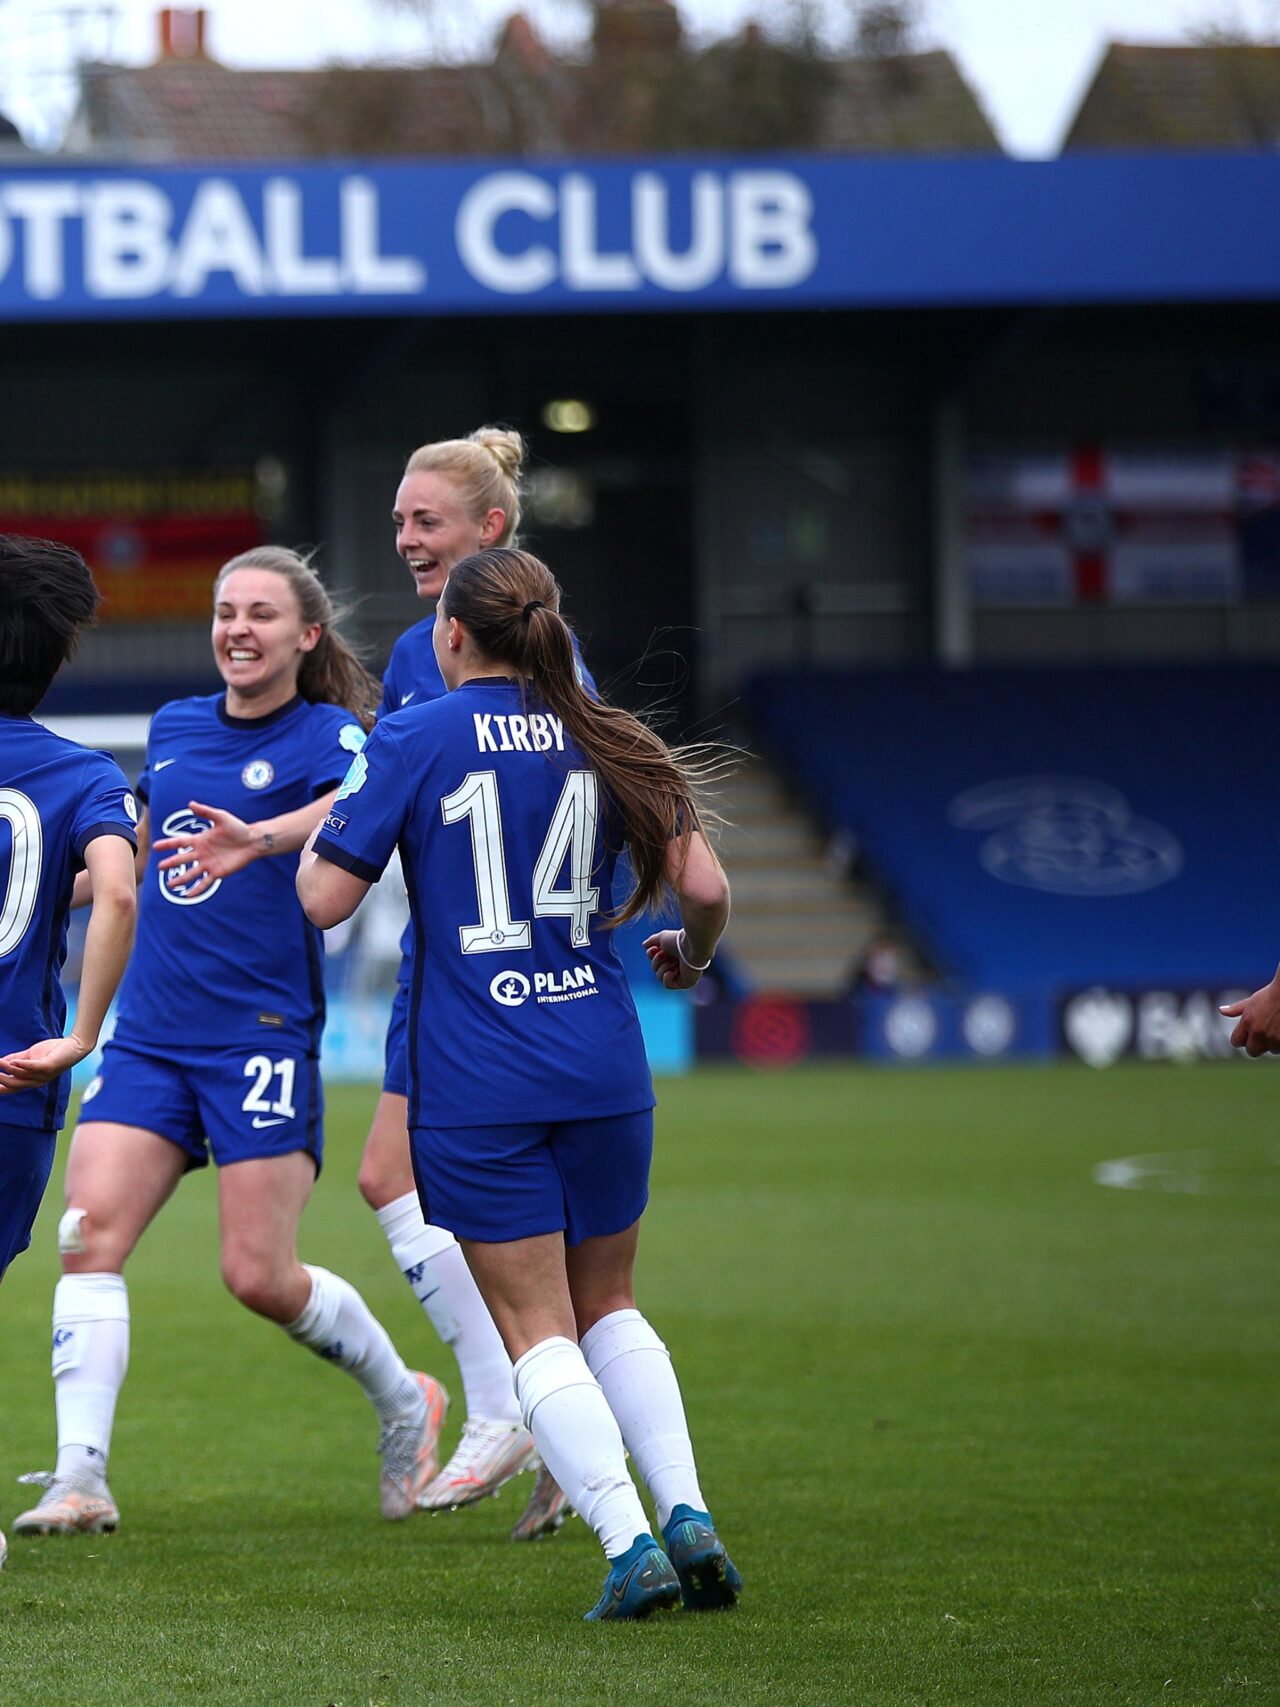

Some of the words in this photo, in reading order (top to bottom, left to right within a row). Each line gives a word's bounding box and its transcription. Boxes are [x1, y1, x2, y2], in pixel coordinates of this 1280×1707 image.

[455, 169, 817, 294] CLUB
[473, 713, 564, 752] KIRBY
[441, 770, 600, 954] 14
[533, 965, 596, 993] PLAN
[537, 986, 599, 1003] INTERNATIONAL
[242, 1055, 296, 1119] 21
